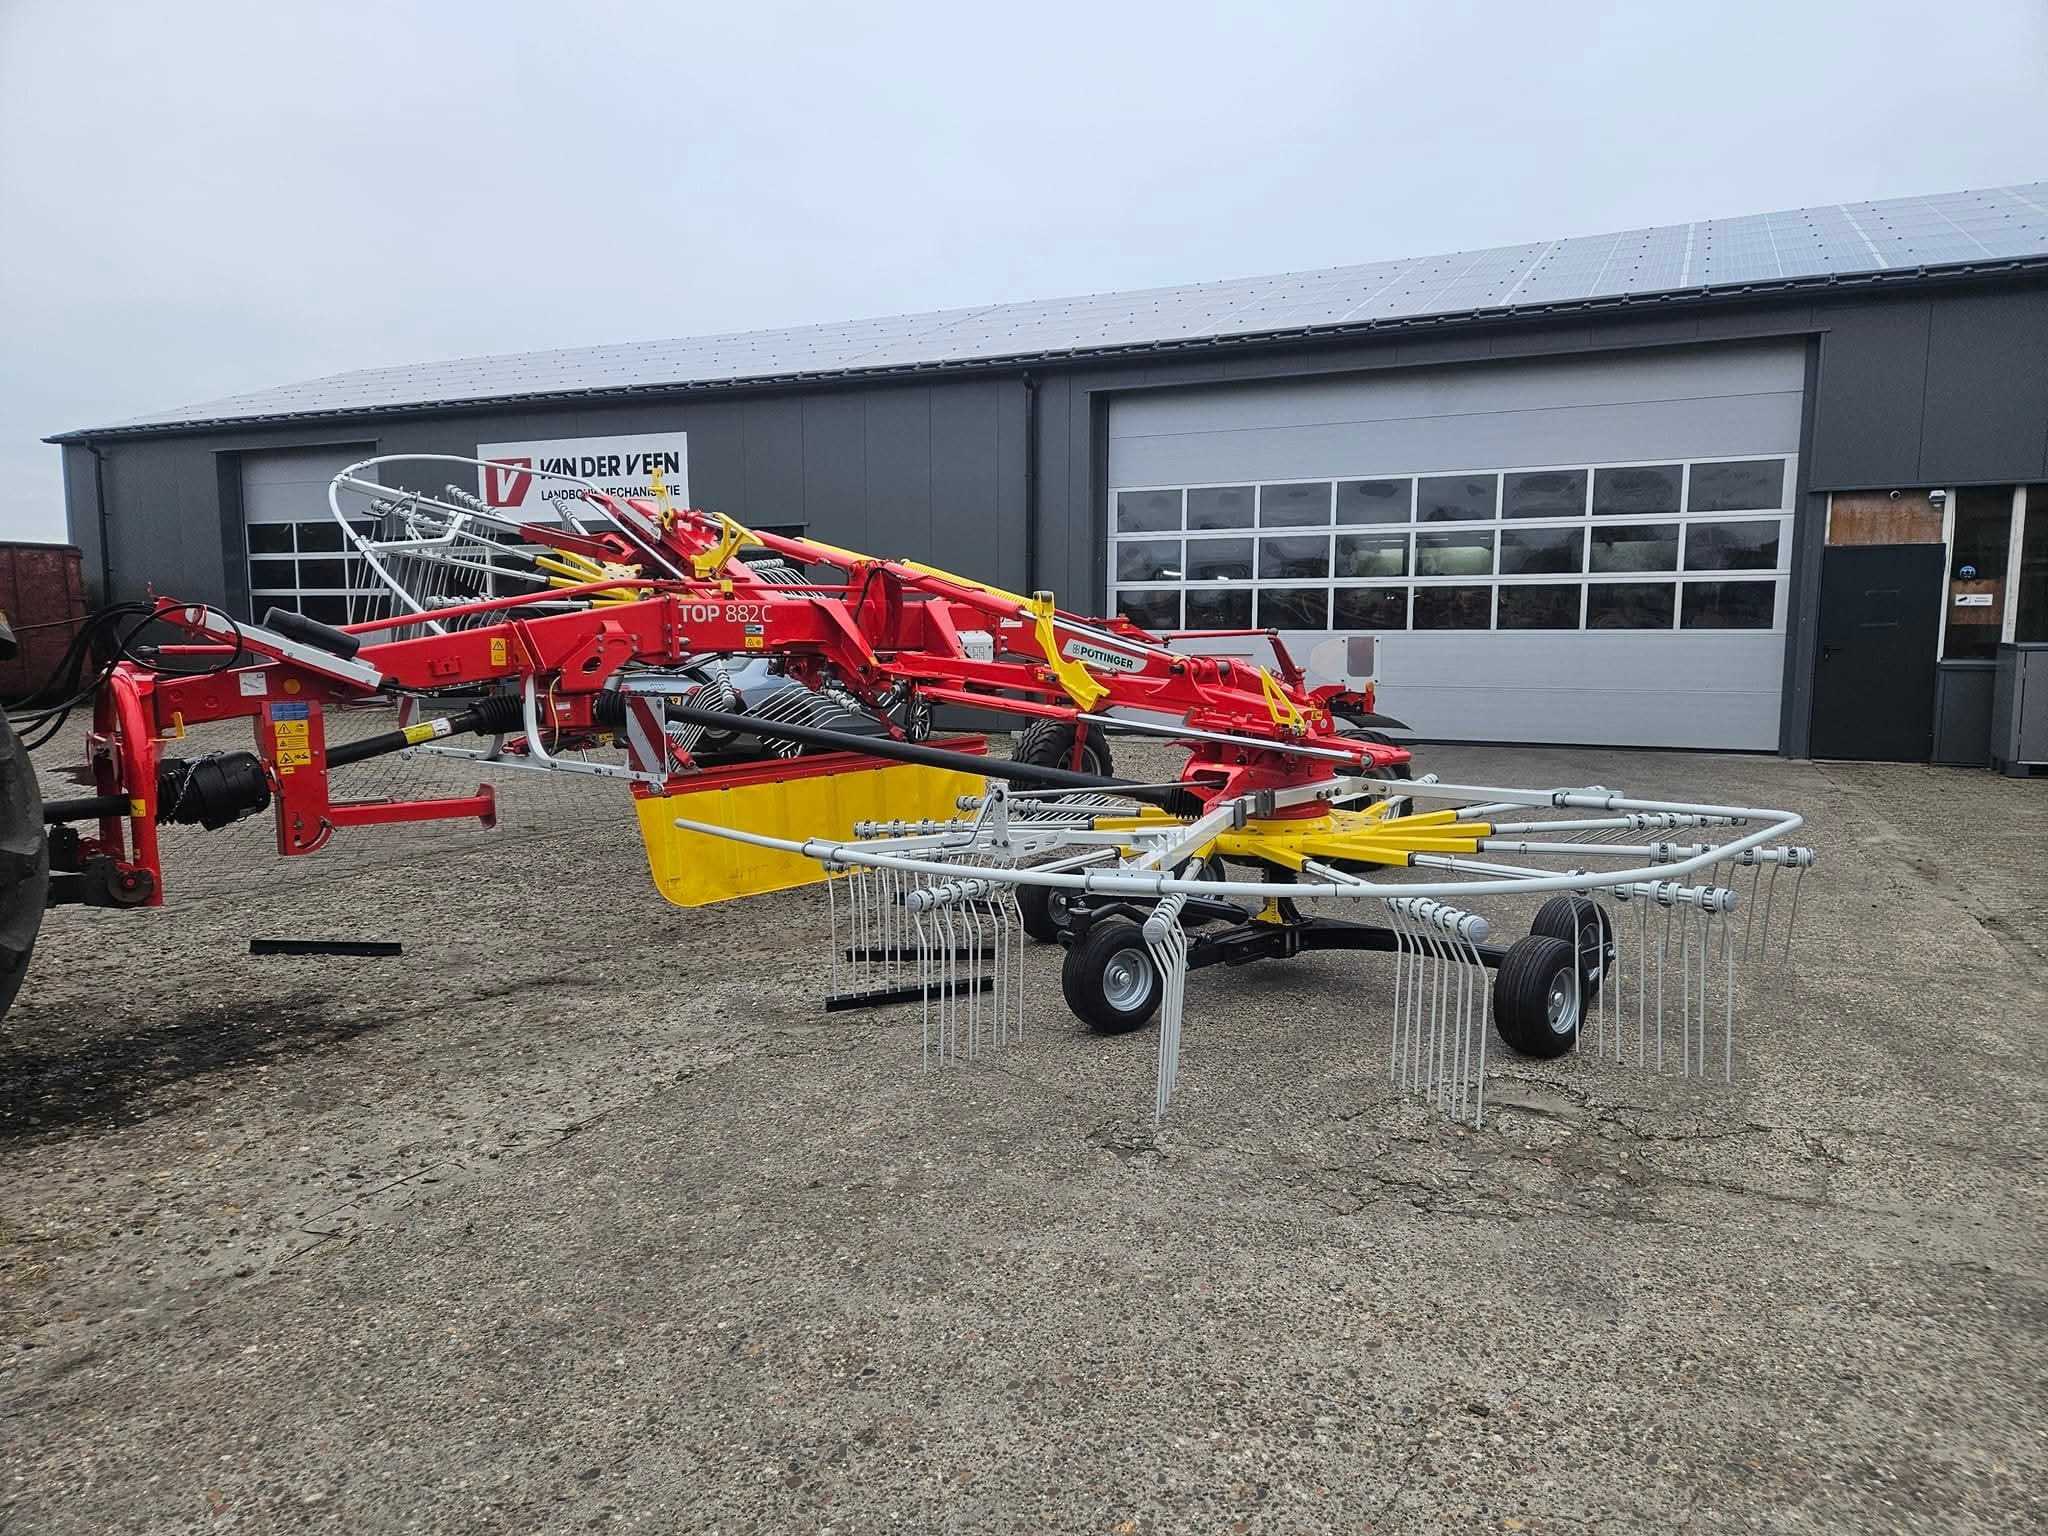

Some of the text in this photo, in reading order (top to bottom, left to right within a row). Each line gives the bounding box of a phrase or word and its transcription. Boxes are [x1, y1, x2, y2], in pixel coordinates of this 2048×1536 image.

[540, 452, 679, 479] VAN DER VEEN
[678, 605, 720, 622] TOP
